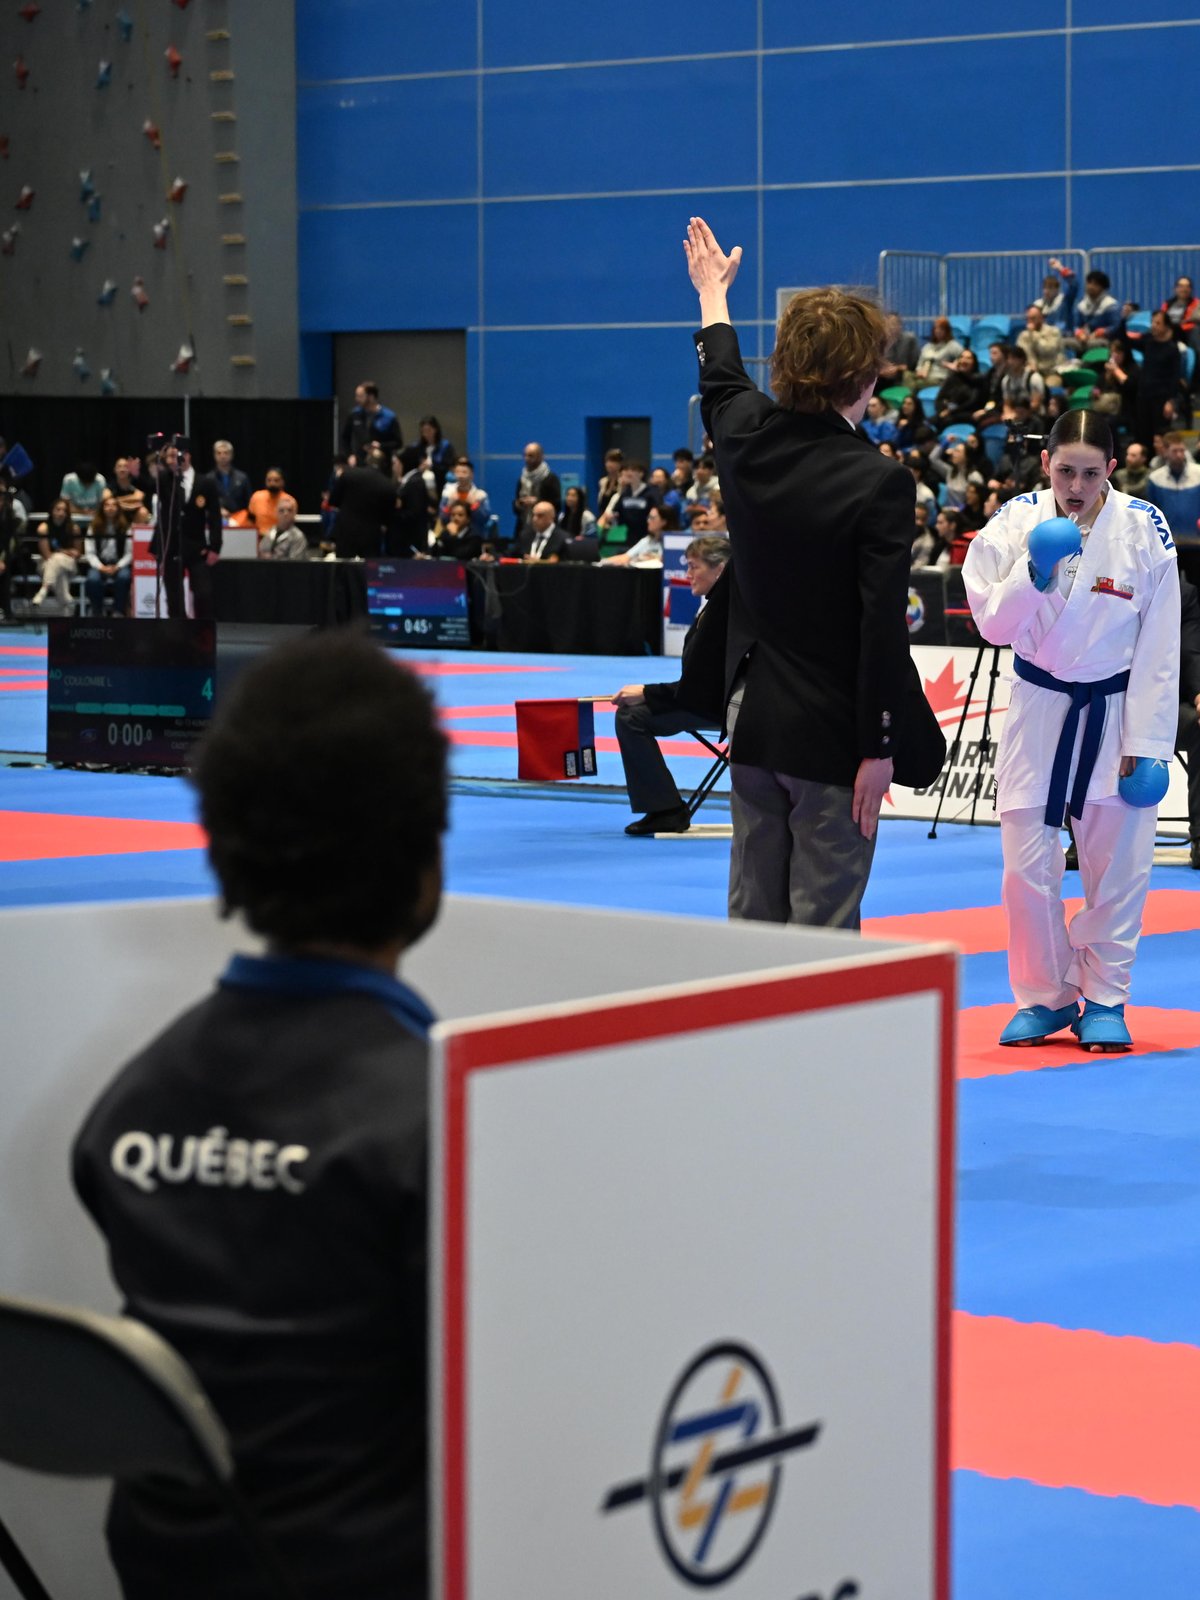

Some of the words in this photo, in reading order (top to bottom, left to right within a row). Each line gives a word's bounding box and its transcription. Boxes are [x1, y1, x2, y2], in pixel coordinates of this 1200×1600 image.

[1127, 499, 1176, 551] SMAI
[202, 677, 213, 700] 4
[110, 1125, 310, 1194] QUÉBEC
